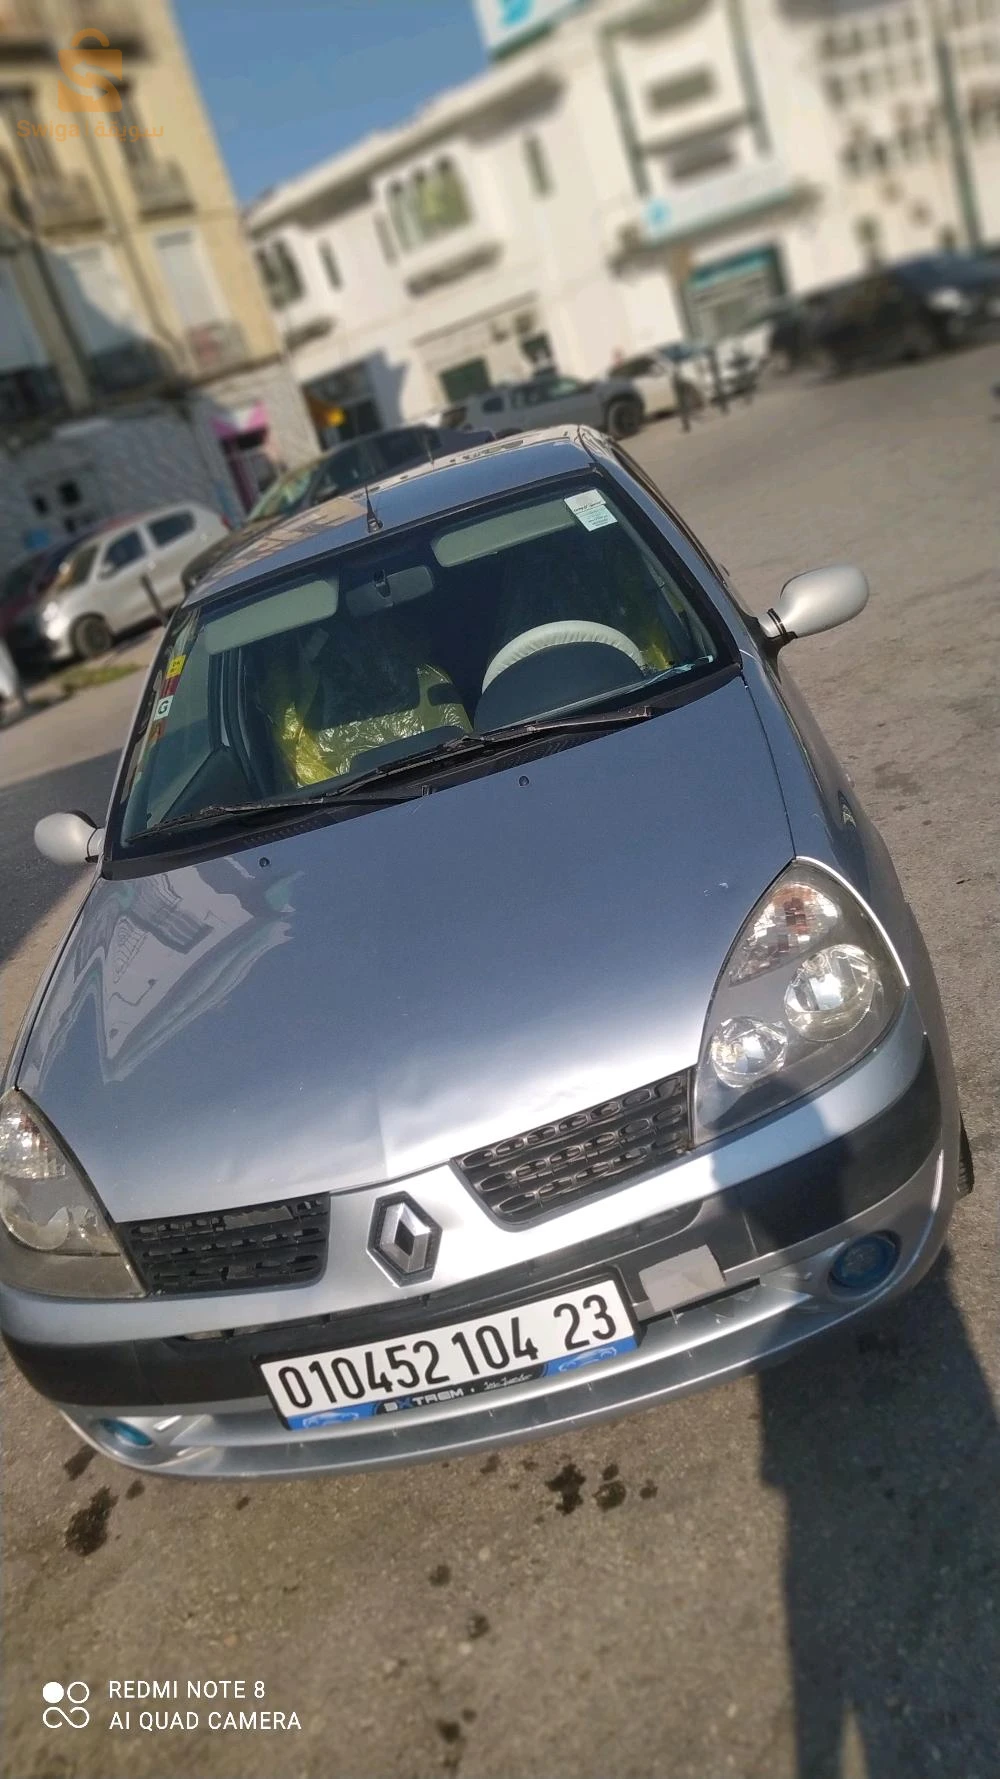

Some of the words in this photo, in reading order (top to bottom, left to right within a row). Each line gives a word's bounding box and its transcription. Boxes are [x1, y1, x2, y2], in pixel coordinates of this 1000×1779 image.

[278, 1340, 450, 1408] 010452
[451, 1316, 539, 1375] 104
[553, 1294, 617, 1350] 23
